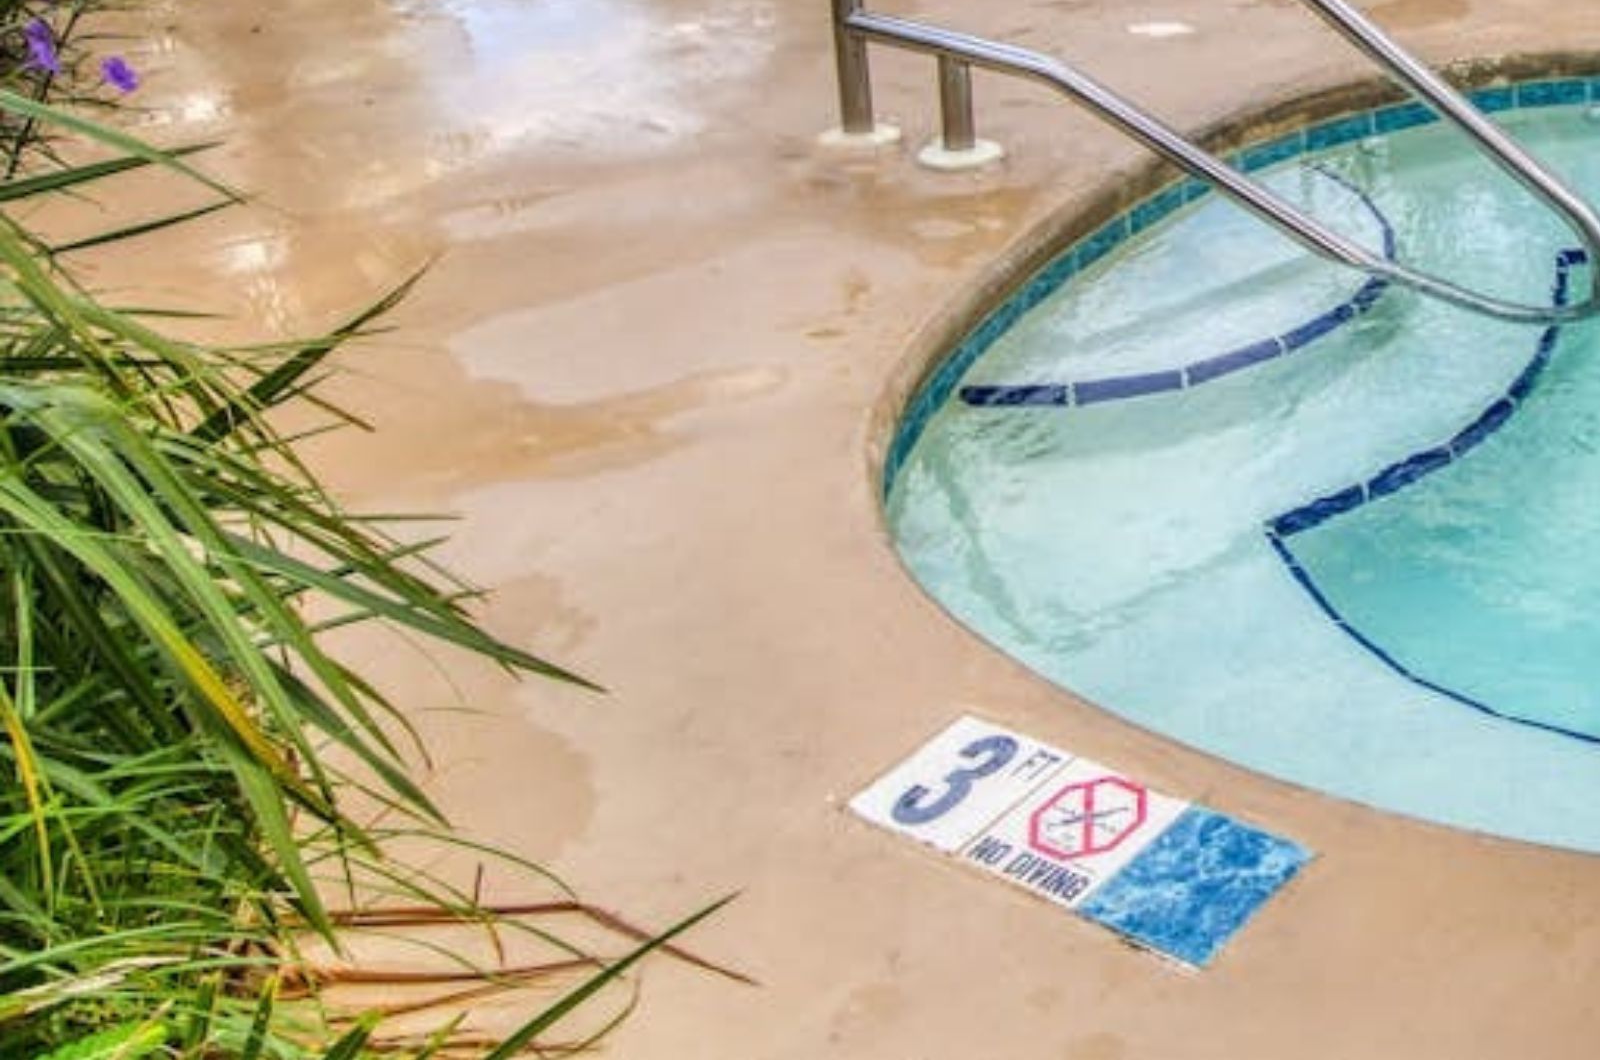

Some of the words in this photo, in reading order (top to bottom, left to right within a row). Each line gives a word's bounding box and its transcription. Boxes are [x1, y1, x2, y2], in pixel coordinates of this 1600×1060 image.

[891, 735, 1019, 825] 3
[1010, 751, 1061, 782] FT
[968, 836, 1012, 865] NO
[1004, 851, 1092, 902] DIVING
